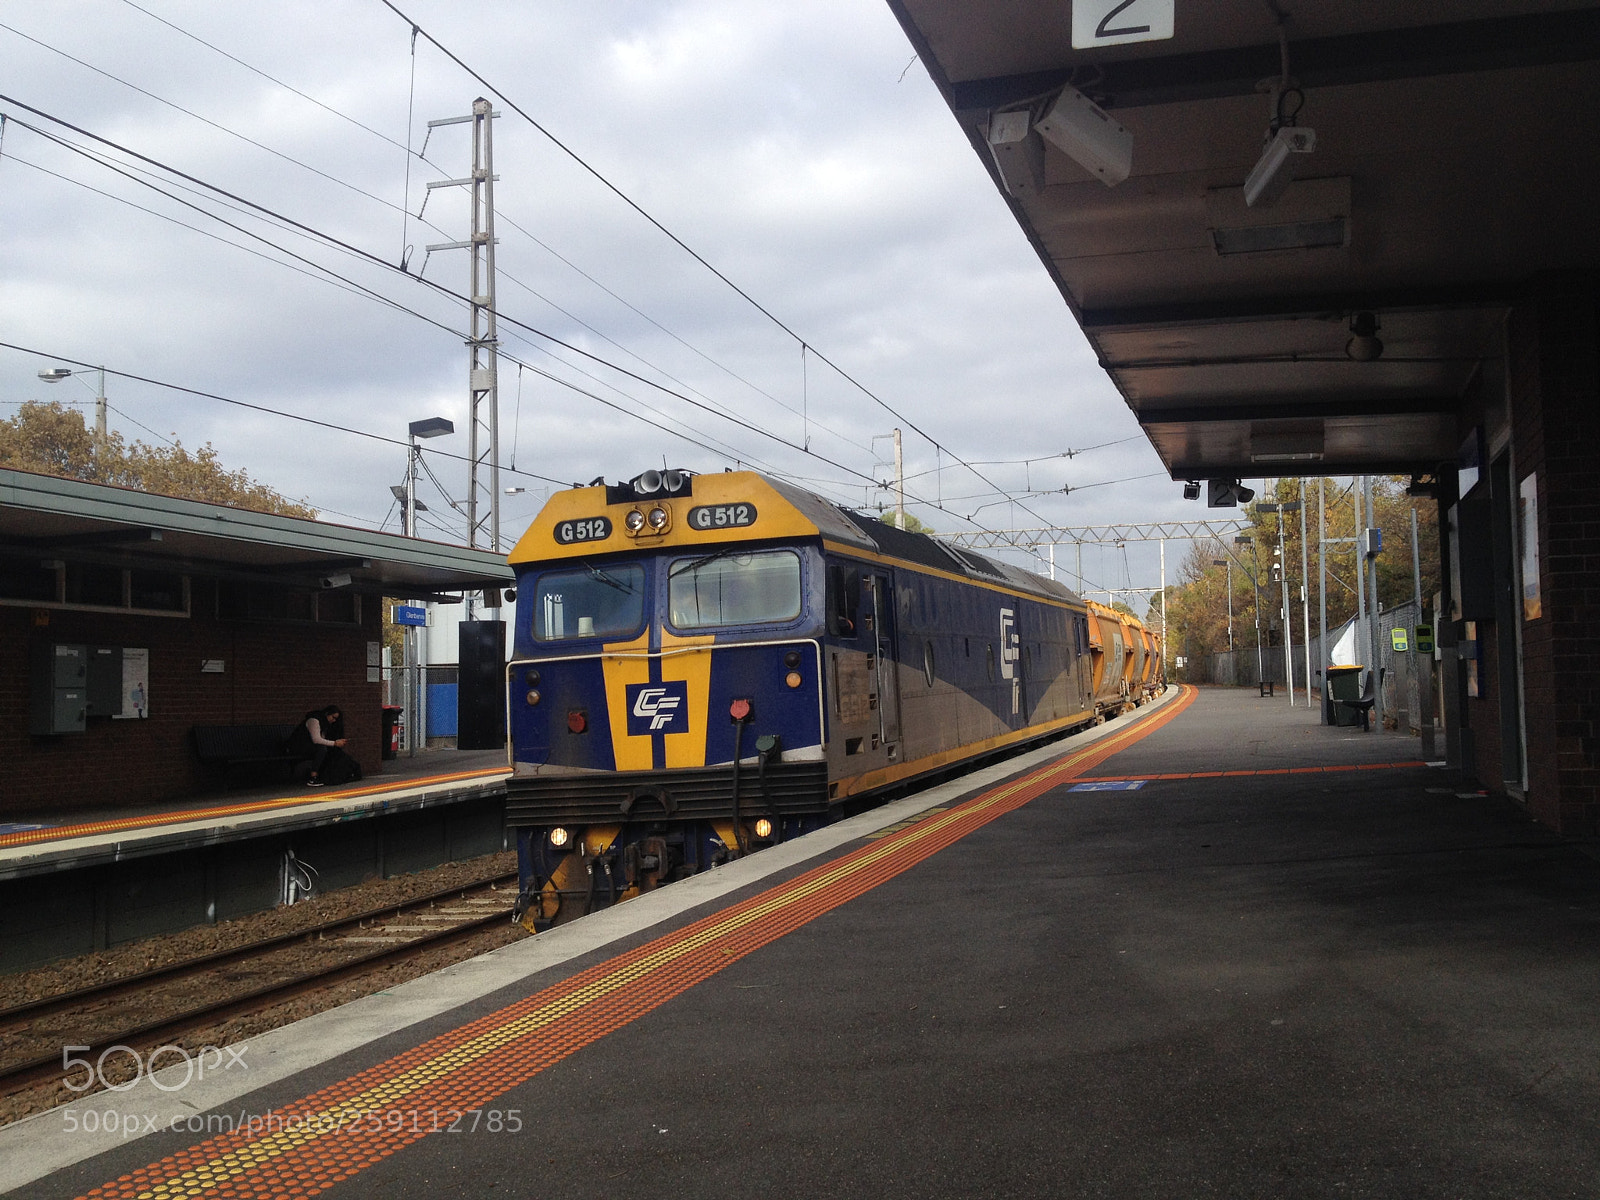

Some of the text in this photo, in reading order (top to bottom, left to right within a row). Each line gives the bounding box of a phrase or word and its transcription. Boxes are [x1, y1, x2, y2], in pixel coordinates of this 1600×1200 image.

[1214, 483, 1231, 505] 2
[696, 505, 749, 527] G 512
[561, 519, 605, 541] G 512
